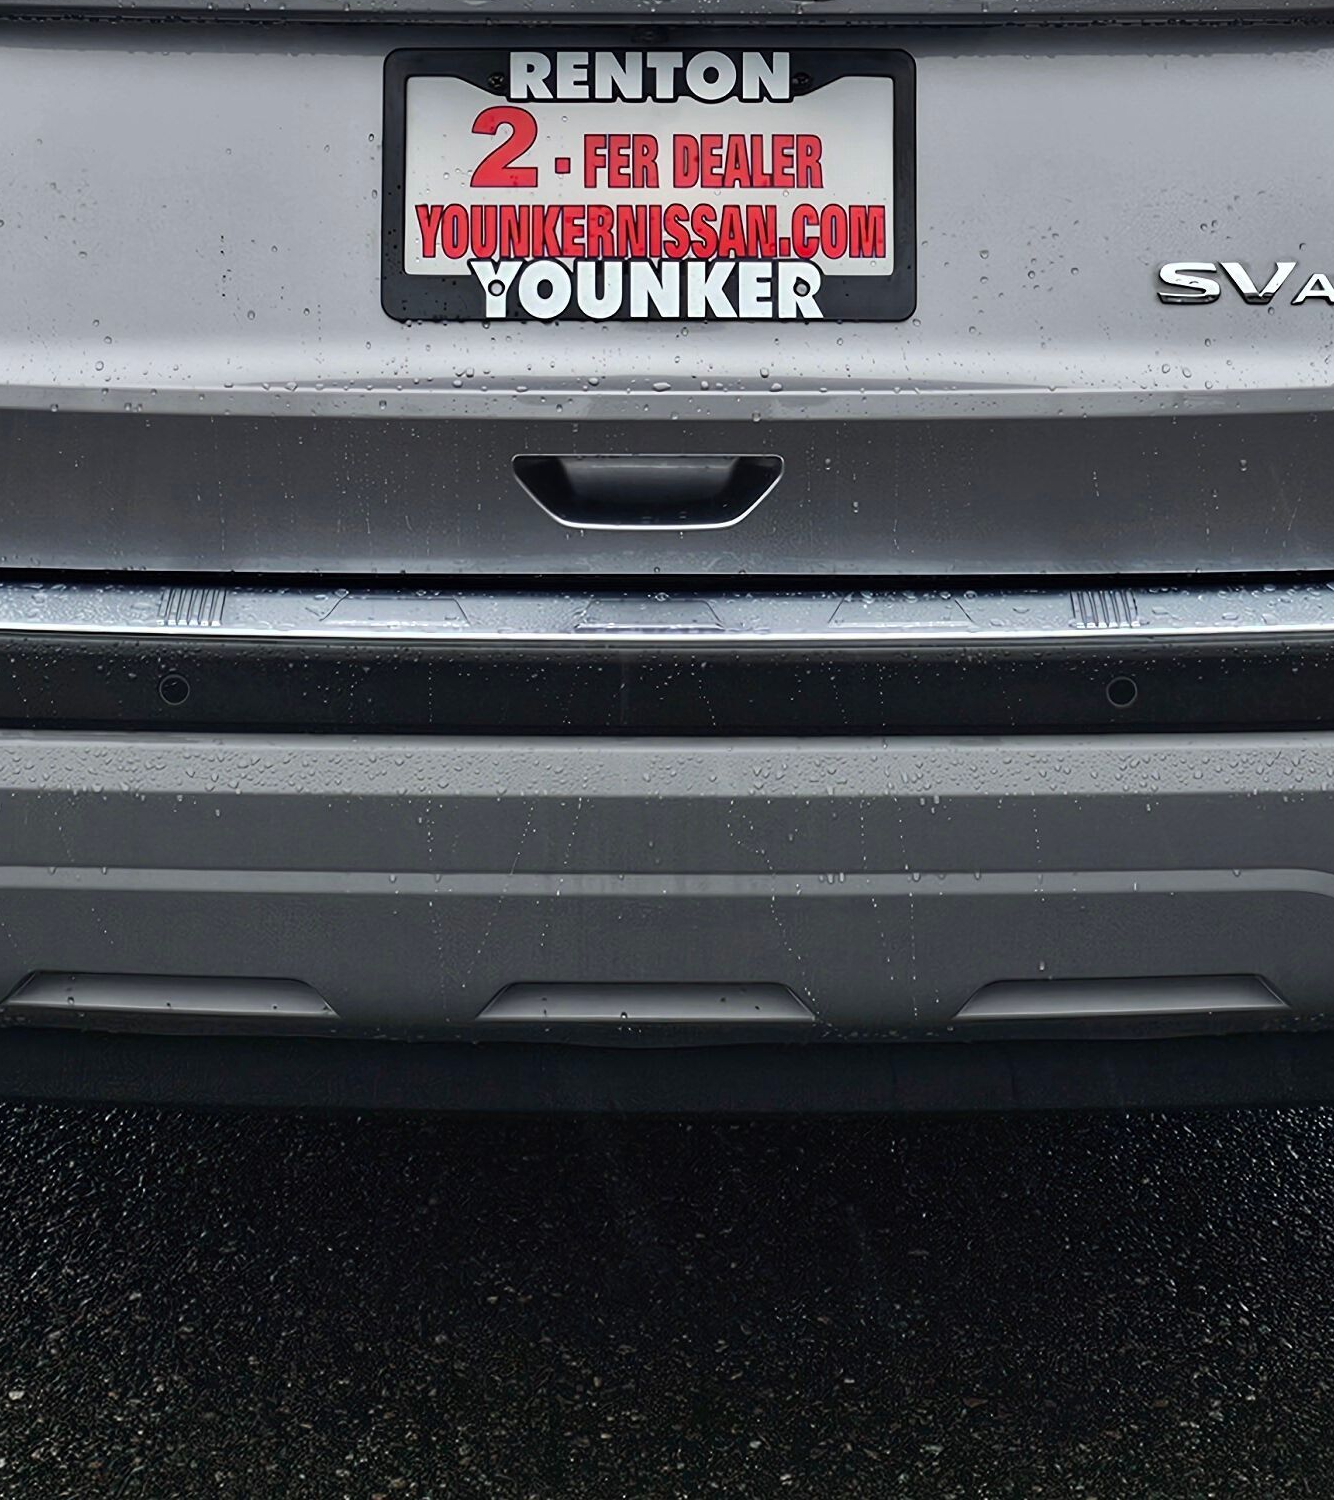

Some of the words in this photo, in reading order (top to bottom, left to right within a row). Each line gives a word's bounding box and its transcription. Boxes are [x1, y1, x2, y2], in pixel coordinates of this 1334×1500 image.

[508, 50, 791, 101] RENTON
[672, 133, 824, 189] DEALER
[414, 203, 887, 259] YOUNKERNISSAN.COM
[471, 260, 825, 319] YOUNKER
